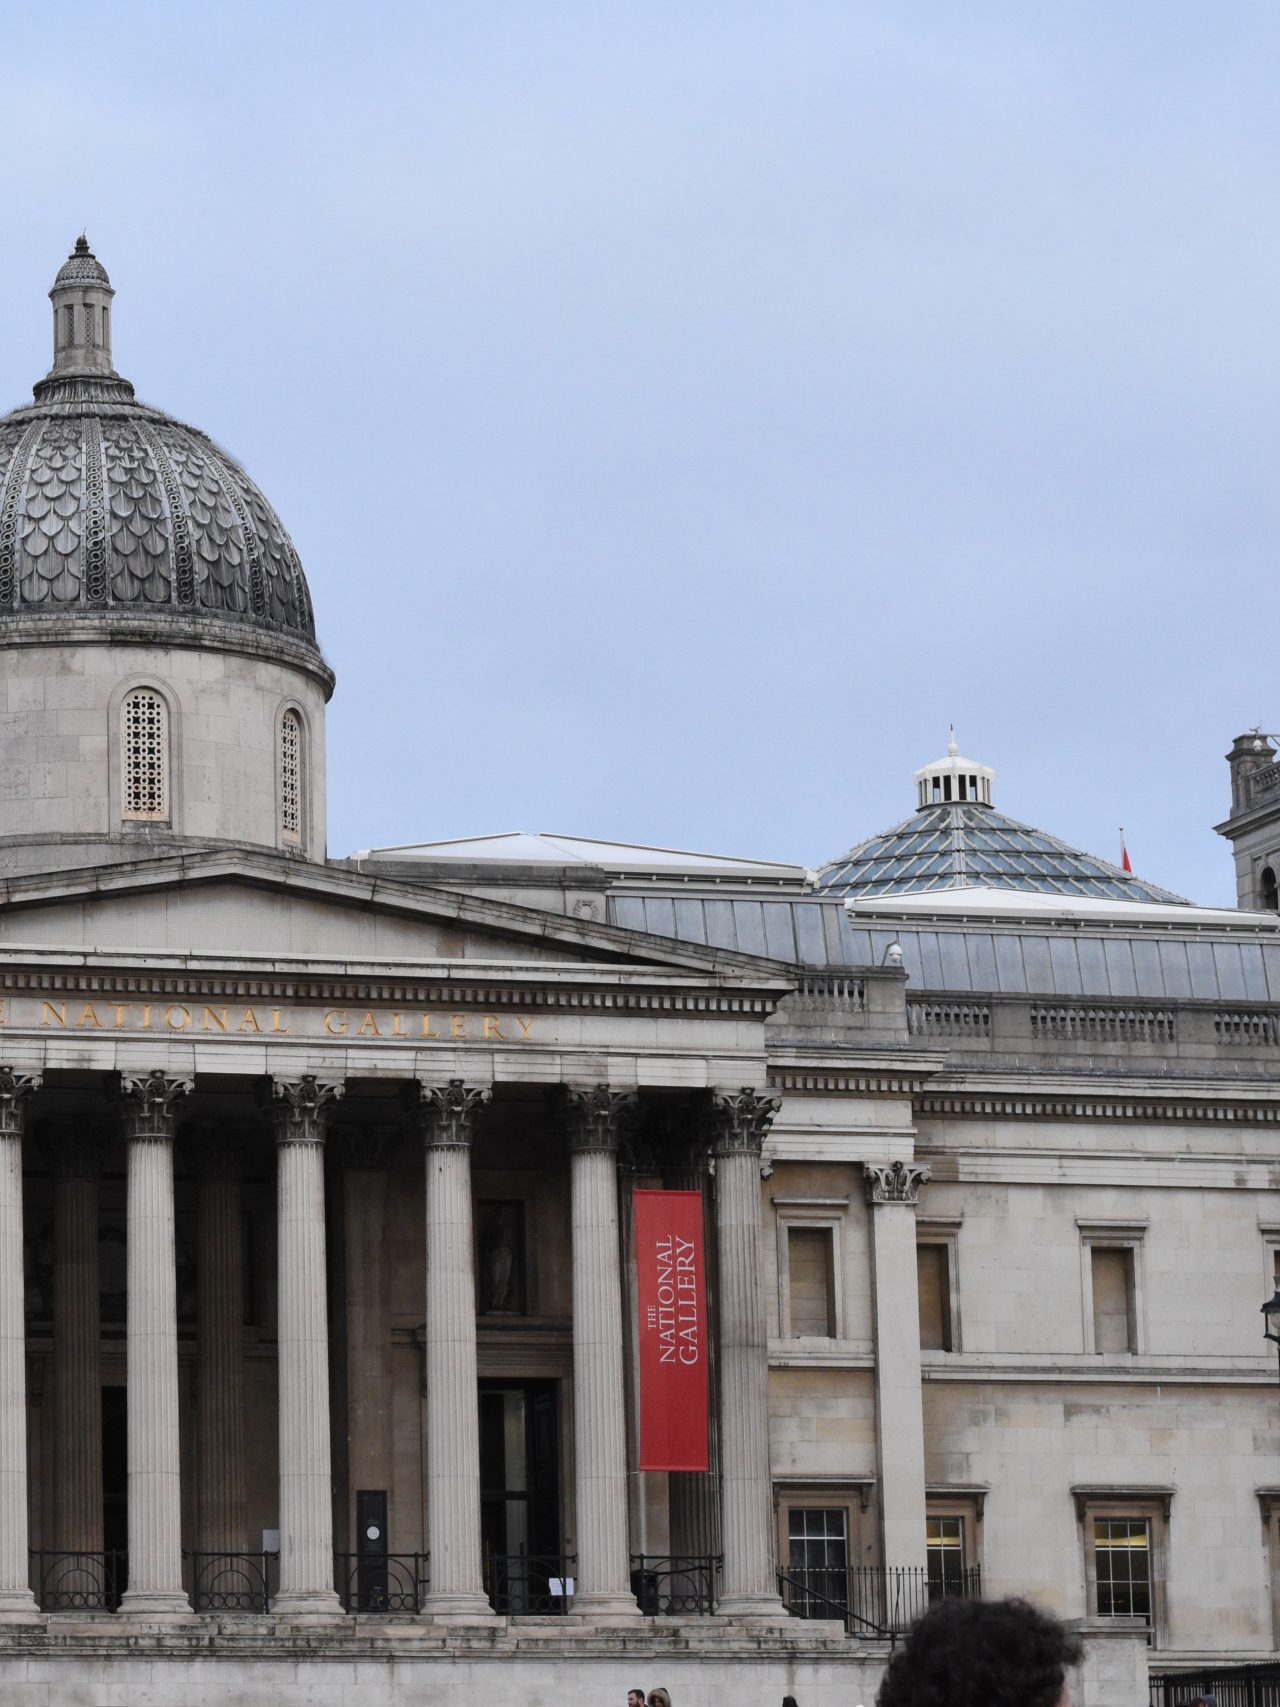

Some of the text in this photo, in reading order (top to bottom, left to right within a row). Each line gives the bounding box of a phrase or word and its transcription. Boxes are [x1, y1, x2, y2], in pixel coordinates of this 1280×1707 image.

[40, 1000, 289, 1034] NATIONAL
[323, 1009, 538, 1041] GALLERY
[647, 1304, 656, 1329] THE
[656, 1234, 676, 1364] NATIONAL
[676, 1234, 699, 1365] GALLERY
